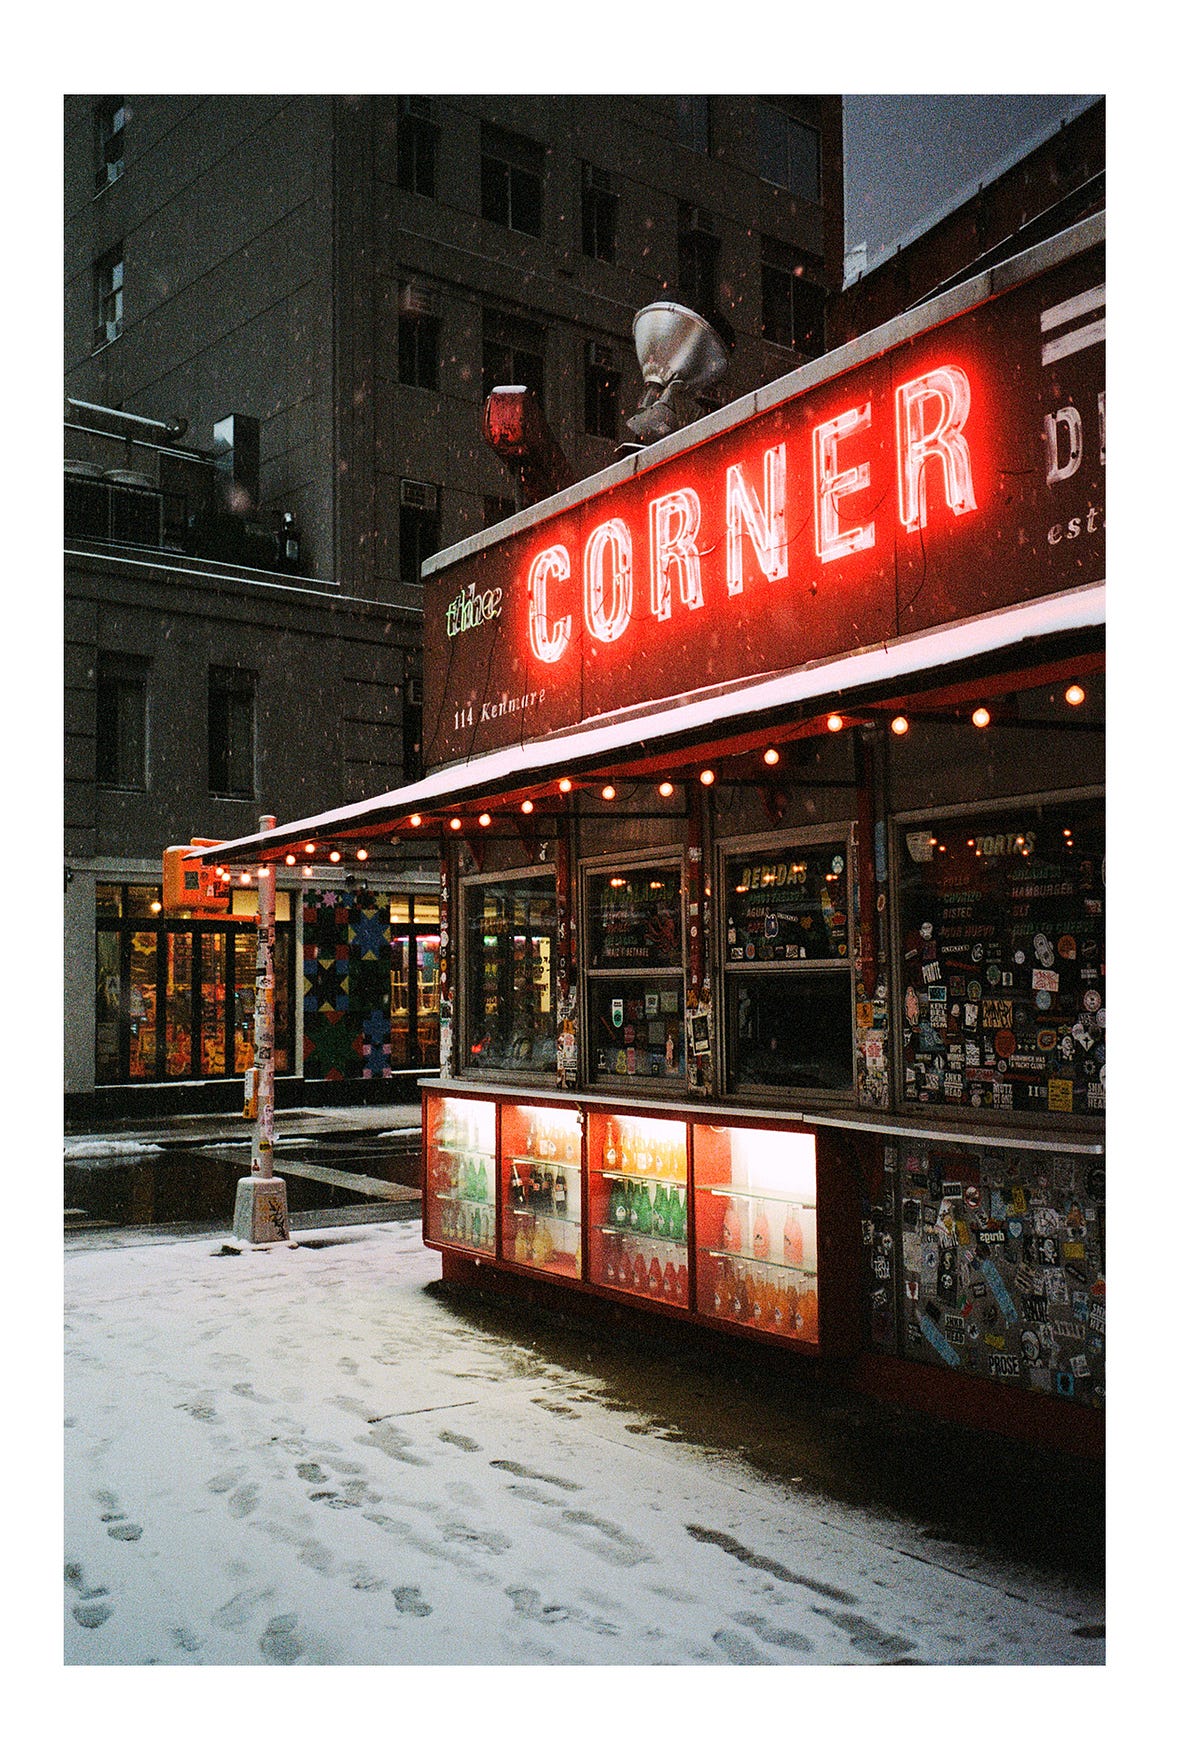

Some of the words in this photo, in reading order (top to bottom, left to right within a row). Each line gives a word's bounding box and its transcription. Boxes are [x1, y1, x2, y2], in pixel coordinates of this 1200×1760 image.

[527, 365, 978, 664] CORNER
[446, 582, 503, 637] the
[454, 707, 473, 730] 114
[480, 688, 546, 722] Kenmare
[975, 831, 1037, 856] TORTAS
[742, 861, 807, 889] BEBIDAS
[1012, 883, 1074, 898] HAMBURGER
[942, 907, 973, 919] BISTEC
[989, 1356, 1020, 1378] PROSE
